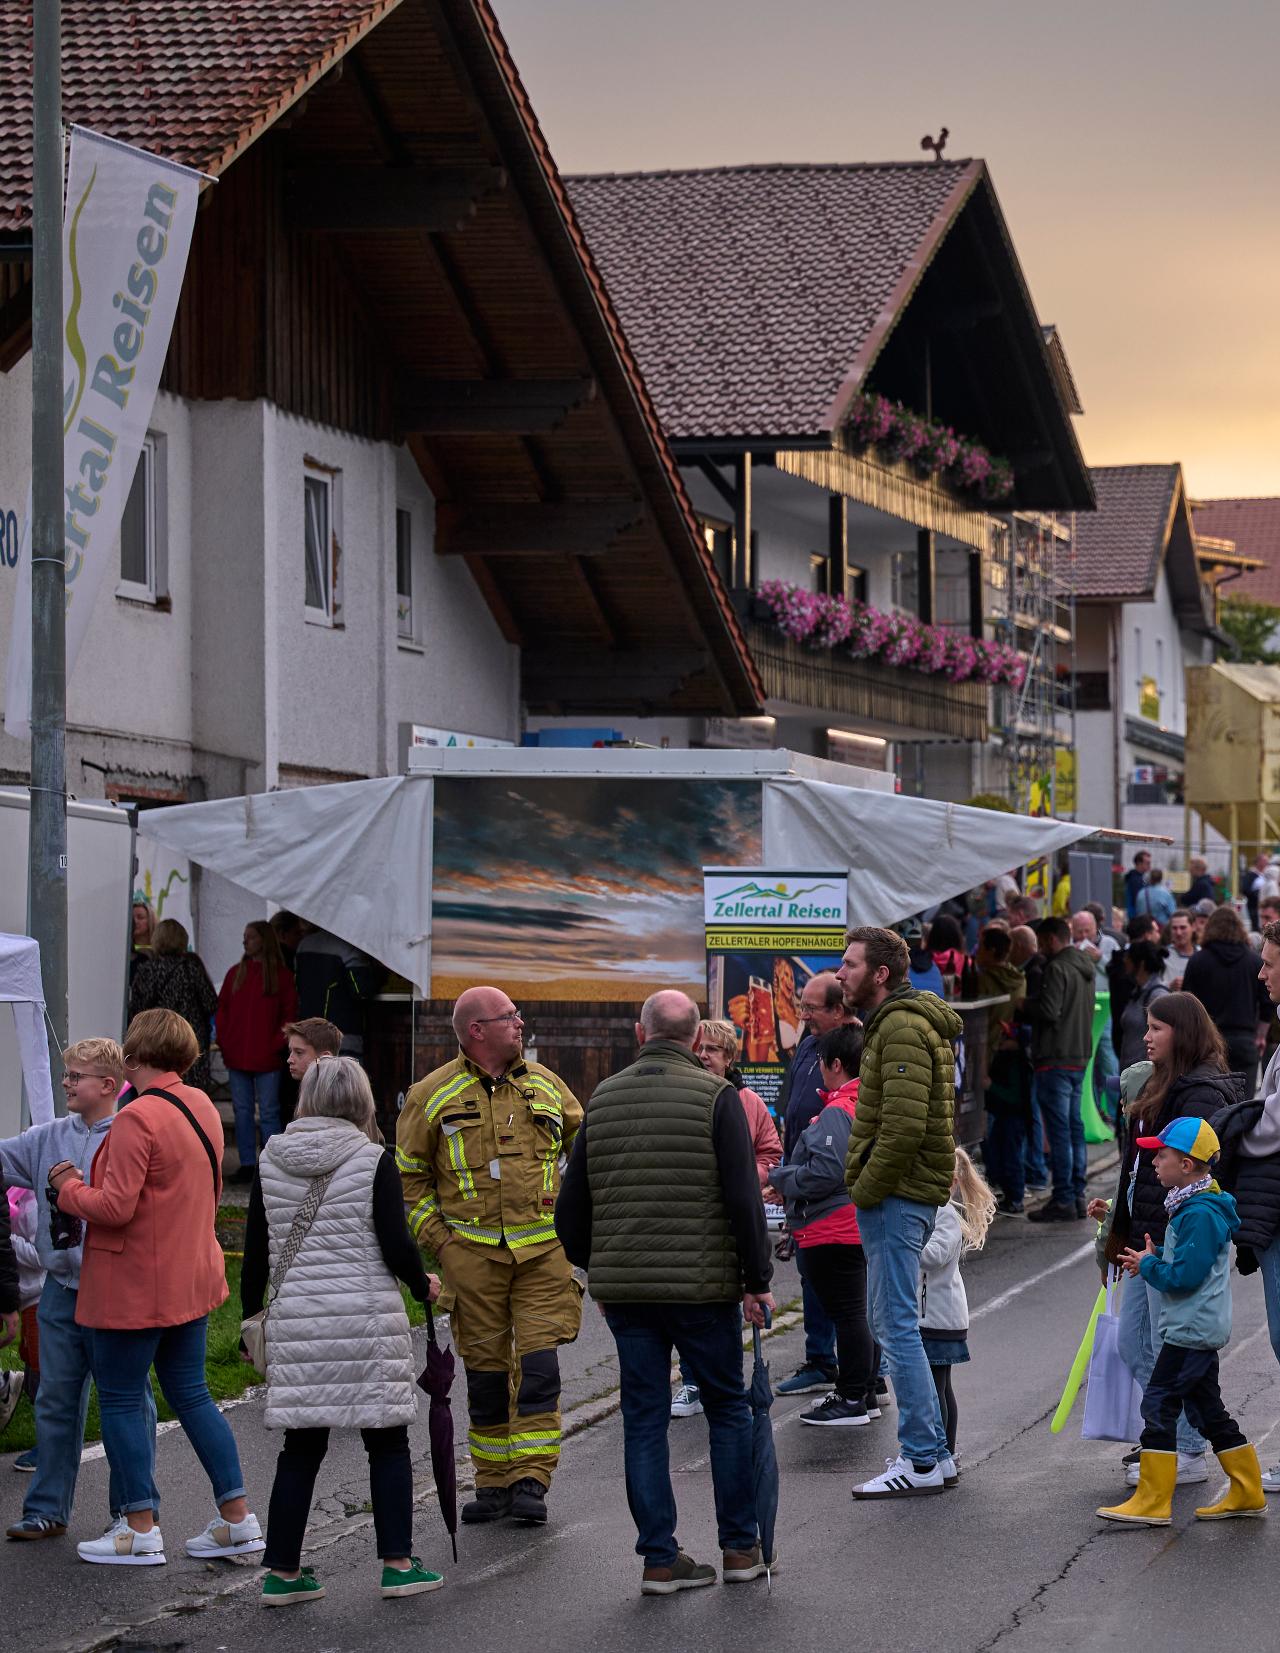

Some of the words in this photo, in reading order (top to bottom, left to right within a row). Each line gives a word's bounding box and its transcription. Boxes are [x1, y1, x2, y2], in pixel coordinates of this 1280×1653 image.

[91, 181, 179, 411] Reisen
[713, 901, 783, 918] Zellertal
[788, 903, 842, 919] Reisen
[709, 936, 771, 946] ZELLERTALER
[772, 935, 844, 948] HOPFENHÄNGER
